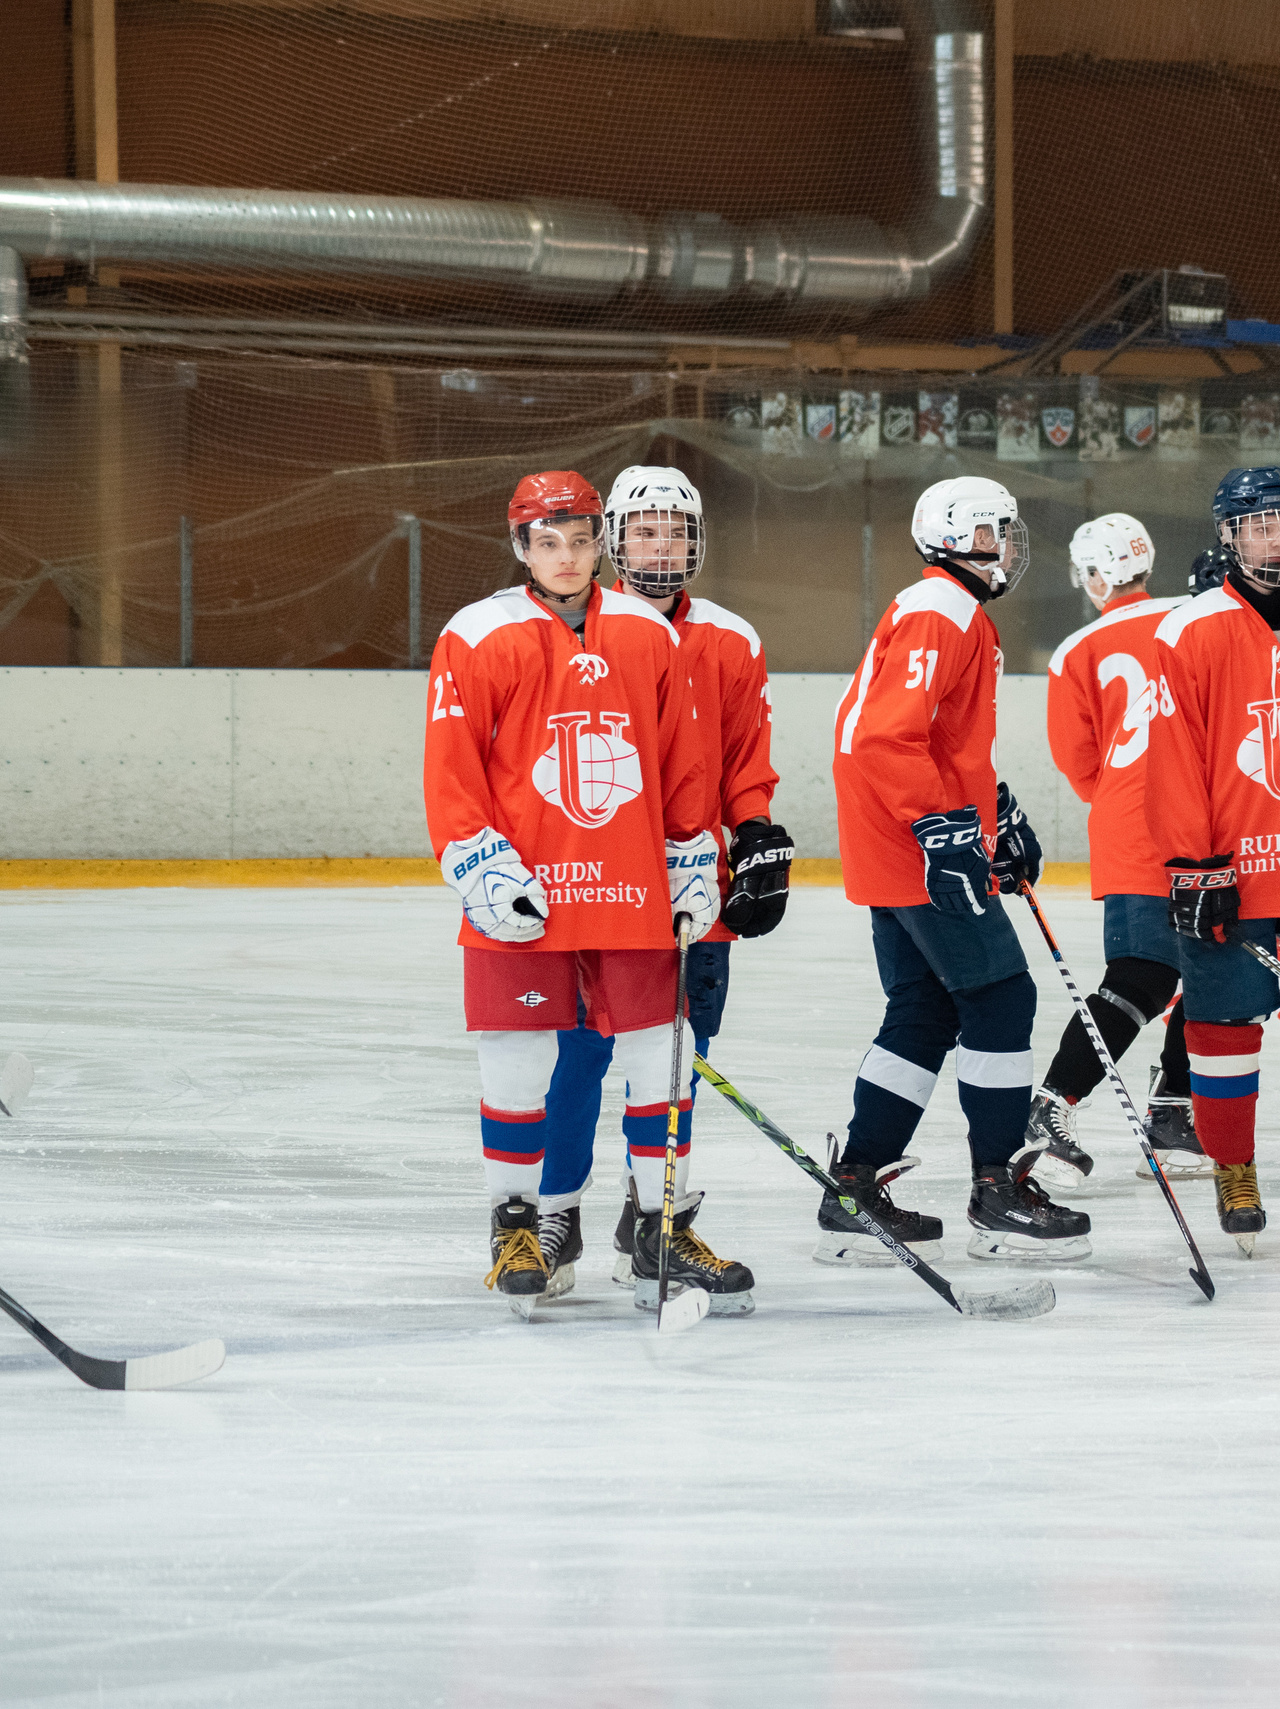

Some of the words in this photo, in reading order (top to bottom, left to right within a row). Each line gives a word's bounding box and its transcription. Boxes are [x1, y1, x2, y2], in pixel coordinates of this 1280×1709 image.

[544, 495, 575, 503] BAUER
[1130, 537, 1148, 556] 66
[905, 647, 939, 692] 51
[924, 824, 982, 849] CC
[534, 862, 603, 884] RUDN
